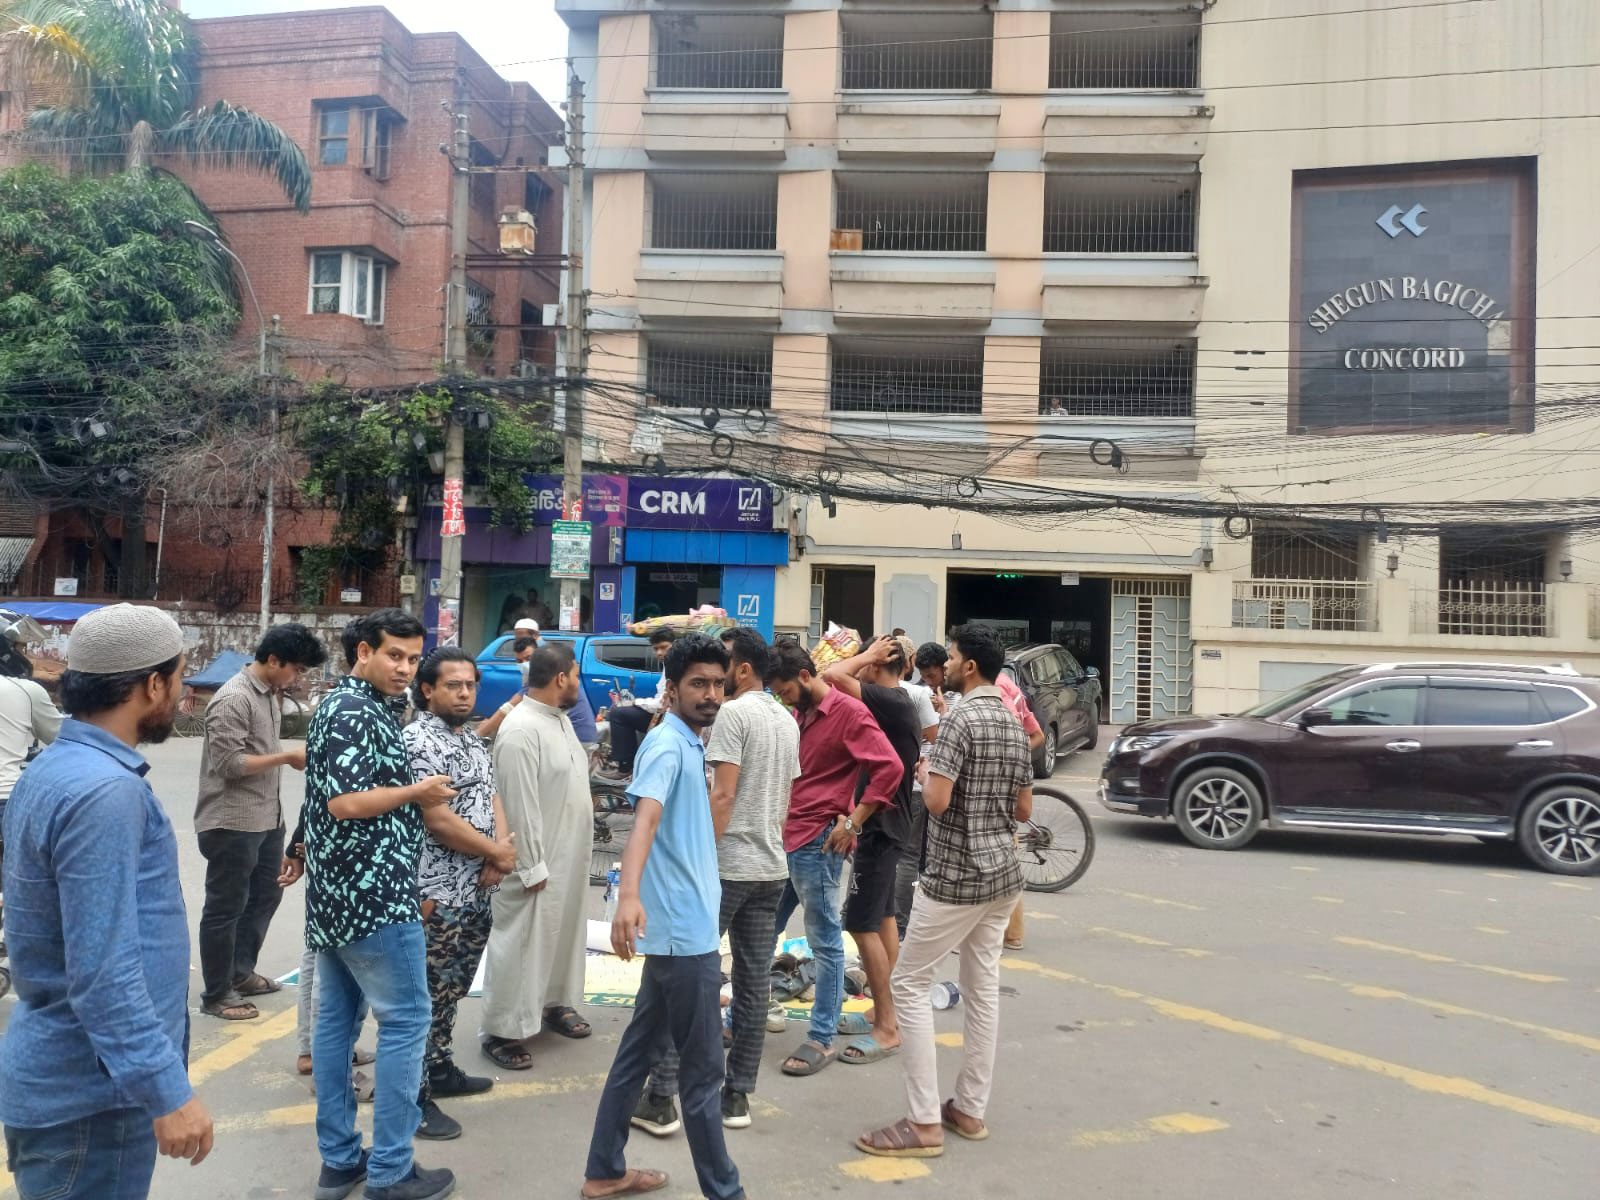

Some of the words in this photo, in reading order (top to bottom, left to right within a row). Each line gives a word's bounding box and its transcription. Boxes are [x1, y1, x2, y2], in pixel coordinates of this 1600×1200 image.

[1308, 277, 1395, 334] SHEGUN
[1402, 276, 1505, 329] BAGICHA
[1344, 347, 1465, 370] CONCORD
[640, 490, 705, 514] CRM
